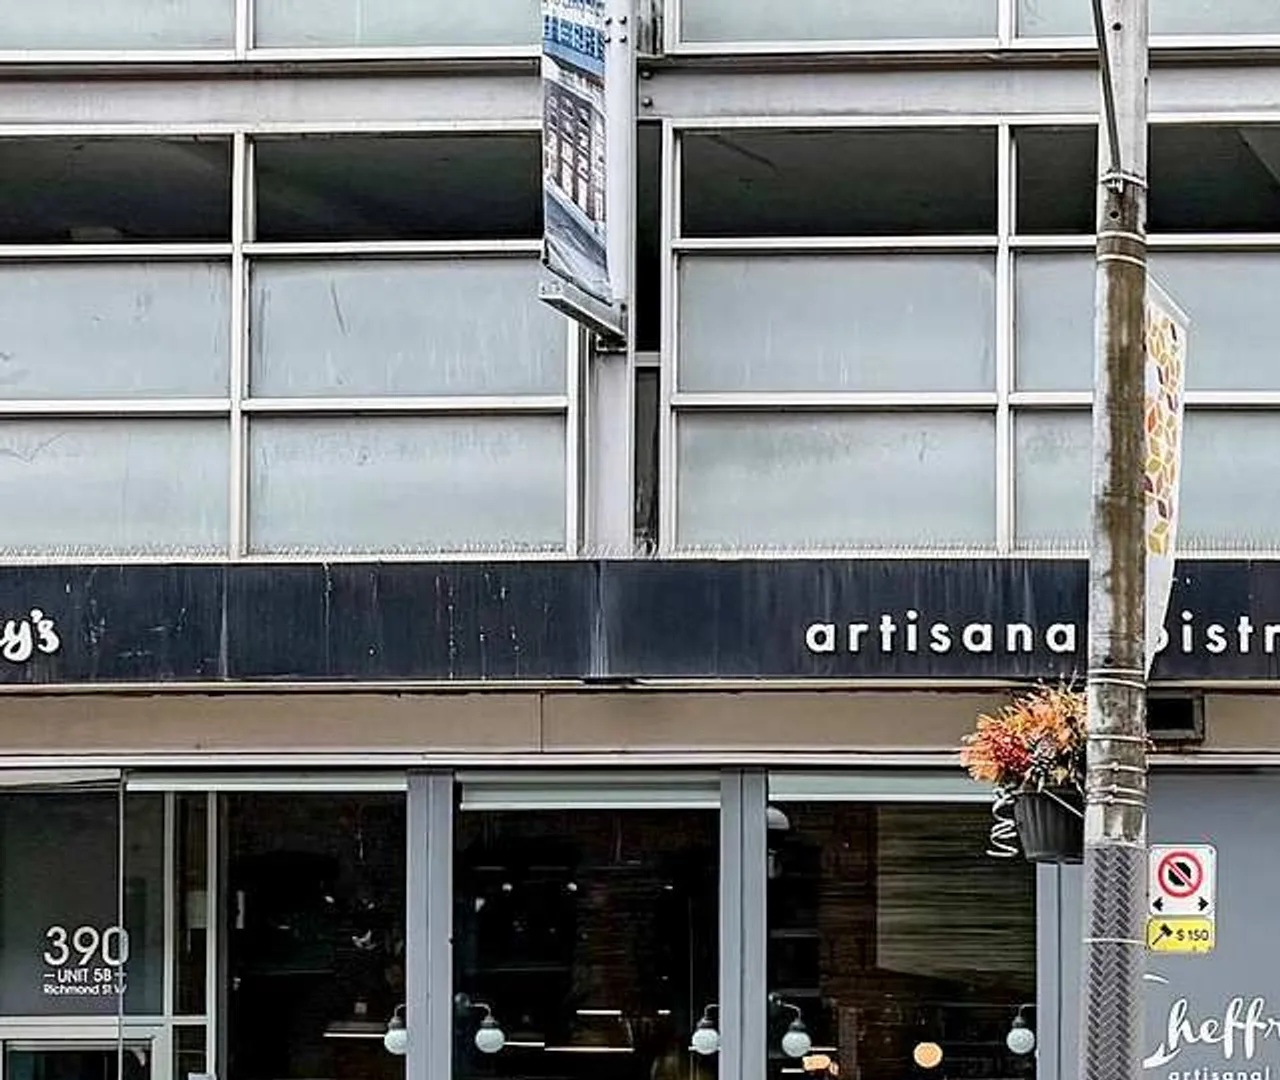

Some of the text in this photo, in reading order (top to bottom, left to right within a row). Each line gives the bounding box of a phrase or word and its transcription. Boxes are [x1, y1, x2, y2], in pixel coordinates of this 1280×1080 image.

[0, 608, 60, 661] y's
[805, 611, 1076, 653] artisana
[43, 926, 129, 966] 390
[43, 983, 100, 995] Richmond
[57, 968, 112, 983] UNIT 5B
